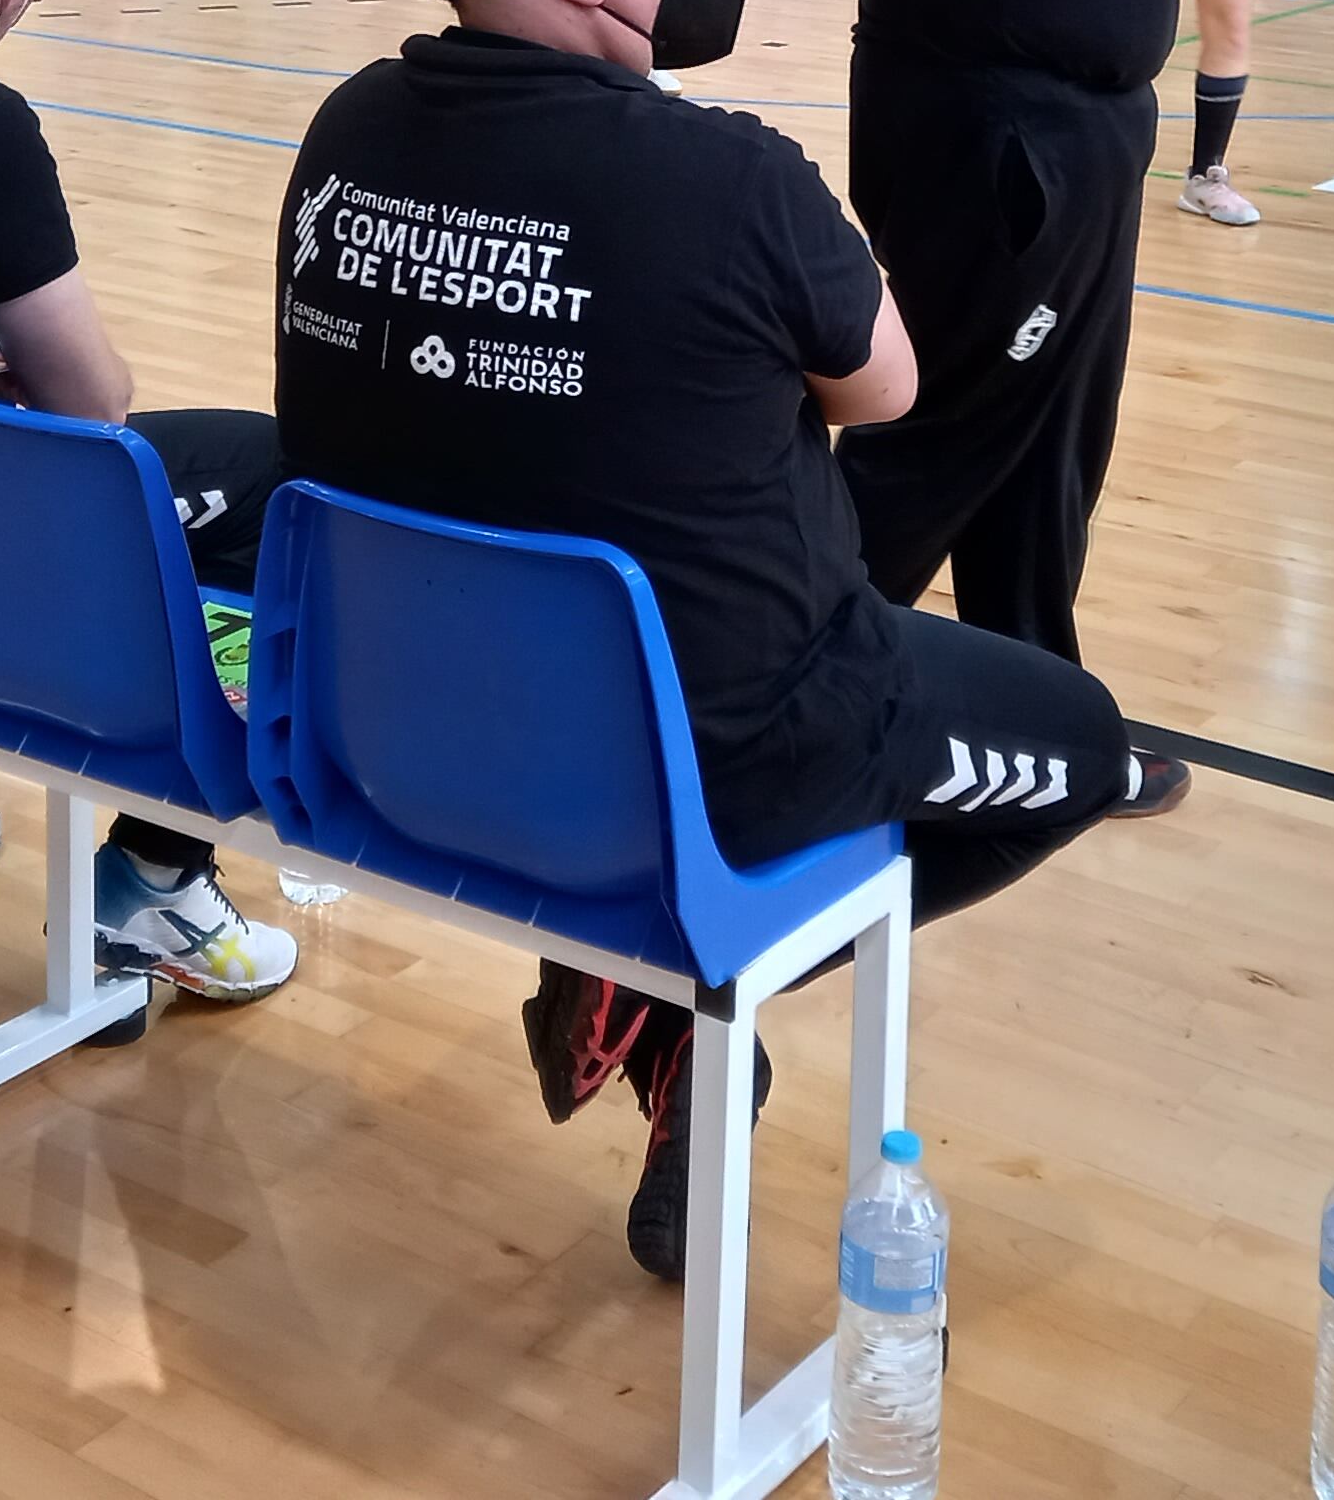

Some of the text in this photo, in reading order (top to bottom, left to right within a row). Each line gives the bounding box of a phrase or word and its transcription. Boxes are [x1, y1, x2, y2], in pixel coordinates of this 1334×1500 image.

[341, 182, 571, 242] Comunitat Valenciana
[333, 208, 564, 280] COMUNITAT
[336, 246, 593, 323] DE L'ESPORT
[292, 314, 359, 351] VALENCIANA
[293, 300, 363, 337] GENERALITAT
[466, 352, 584, 380] TRINIDAD
[468, 338, 586, 362] FUNDACIÓN
[464, 370, 584, 397] ALFONSO
